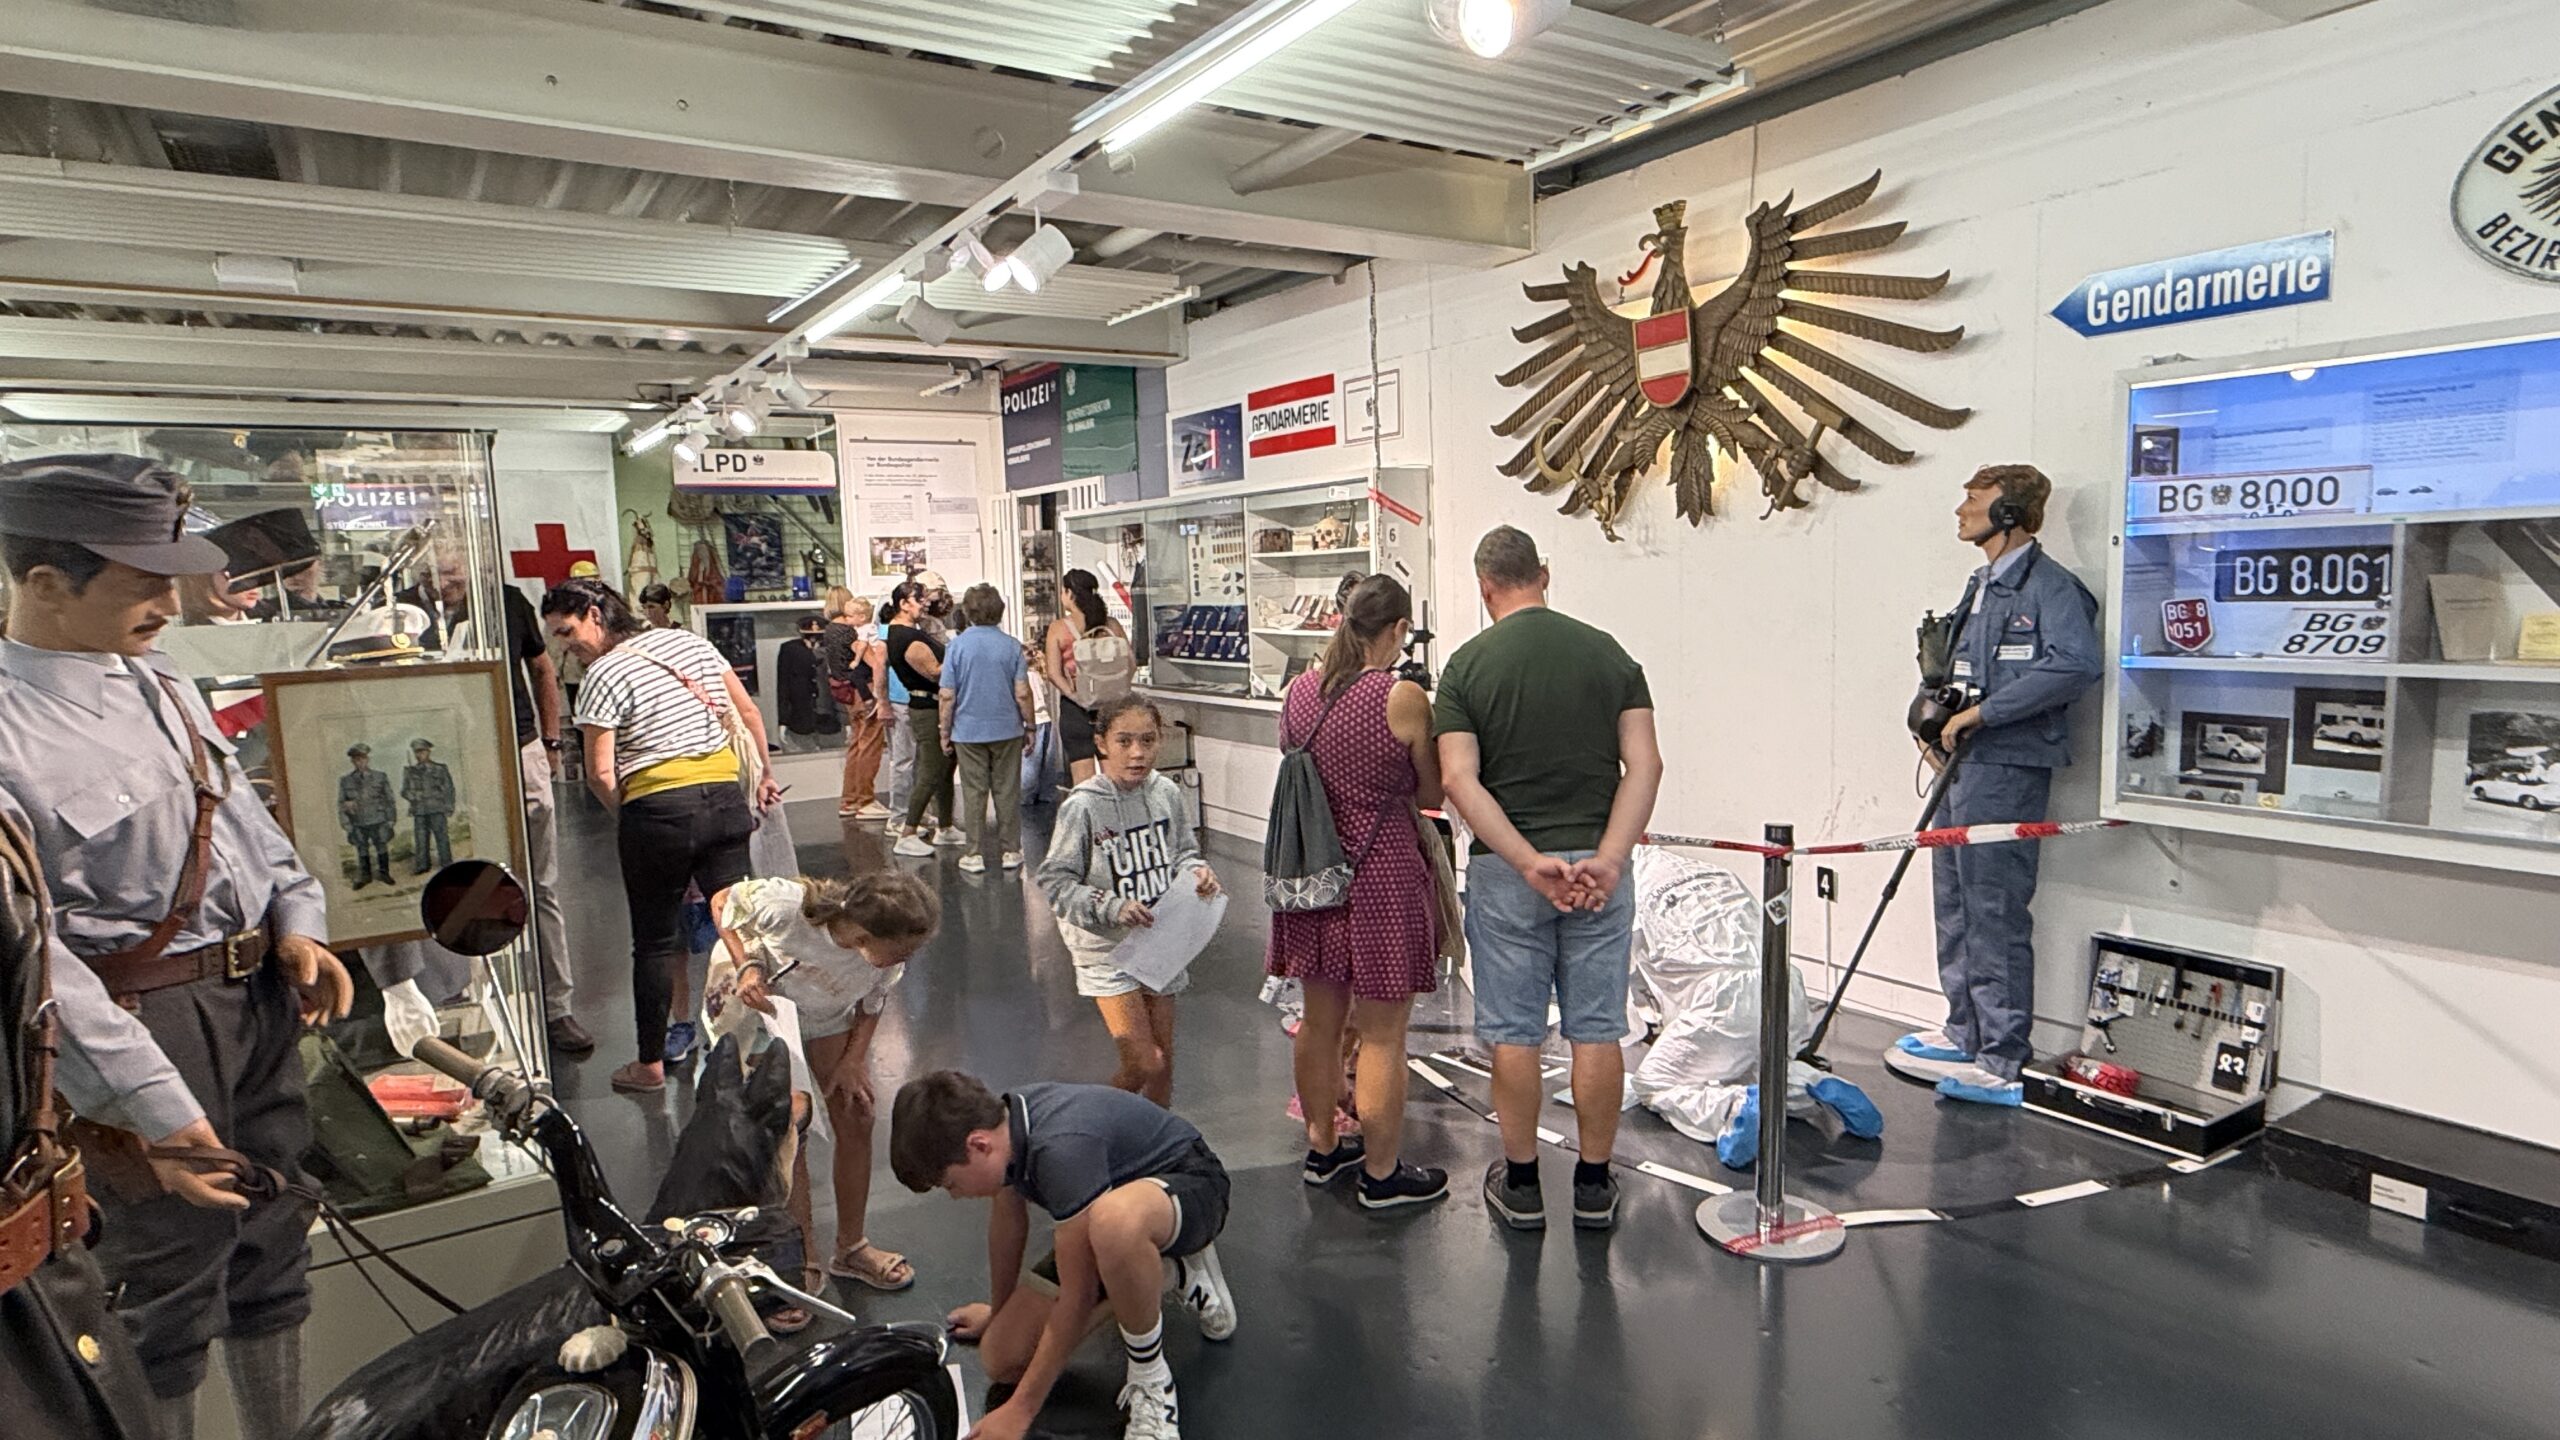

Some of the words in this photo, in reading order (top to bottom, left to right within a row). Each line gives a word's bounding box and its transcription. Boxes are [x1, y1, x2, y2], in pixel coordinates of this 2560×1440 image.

[2087, 254, 2321, 327] Gendarmerie
[1003, 382, 1050, 415] POLIZEI
[1251, 400, 1330, 432] GENDARMERIE
[2159, 484, 2204, 513] BG
[2240, 475, 2340, 509] 8000
[1389, 528, 1396, 542] 6
[2234, 555, 2279, 596] BG
[2290, 552, 2391, 595] 8.061
[2167, 603, 2188, 620] BG
[2196, 602, 2206, 618] 8
[2303, 613, 2357, 633] BG
[2283, 634, 2387, 654] 8709
[1820, 874, 1830, 893] 4
[1189, 1285, 1210, 1311] N
